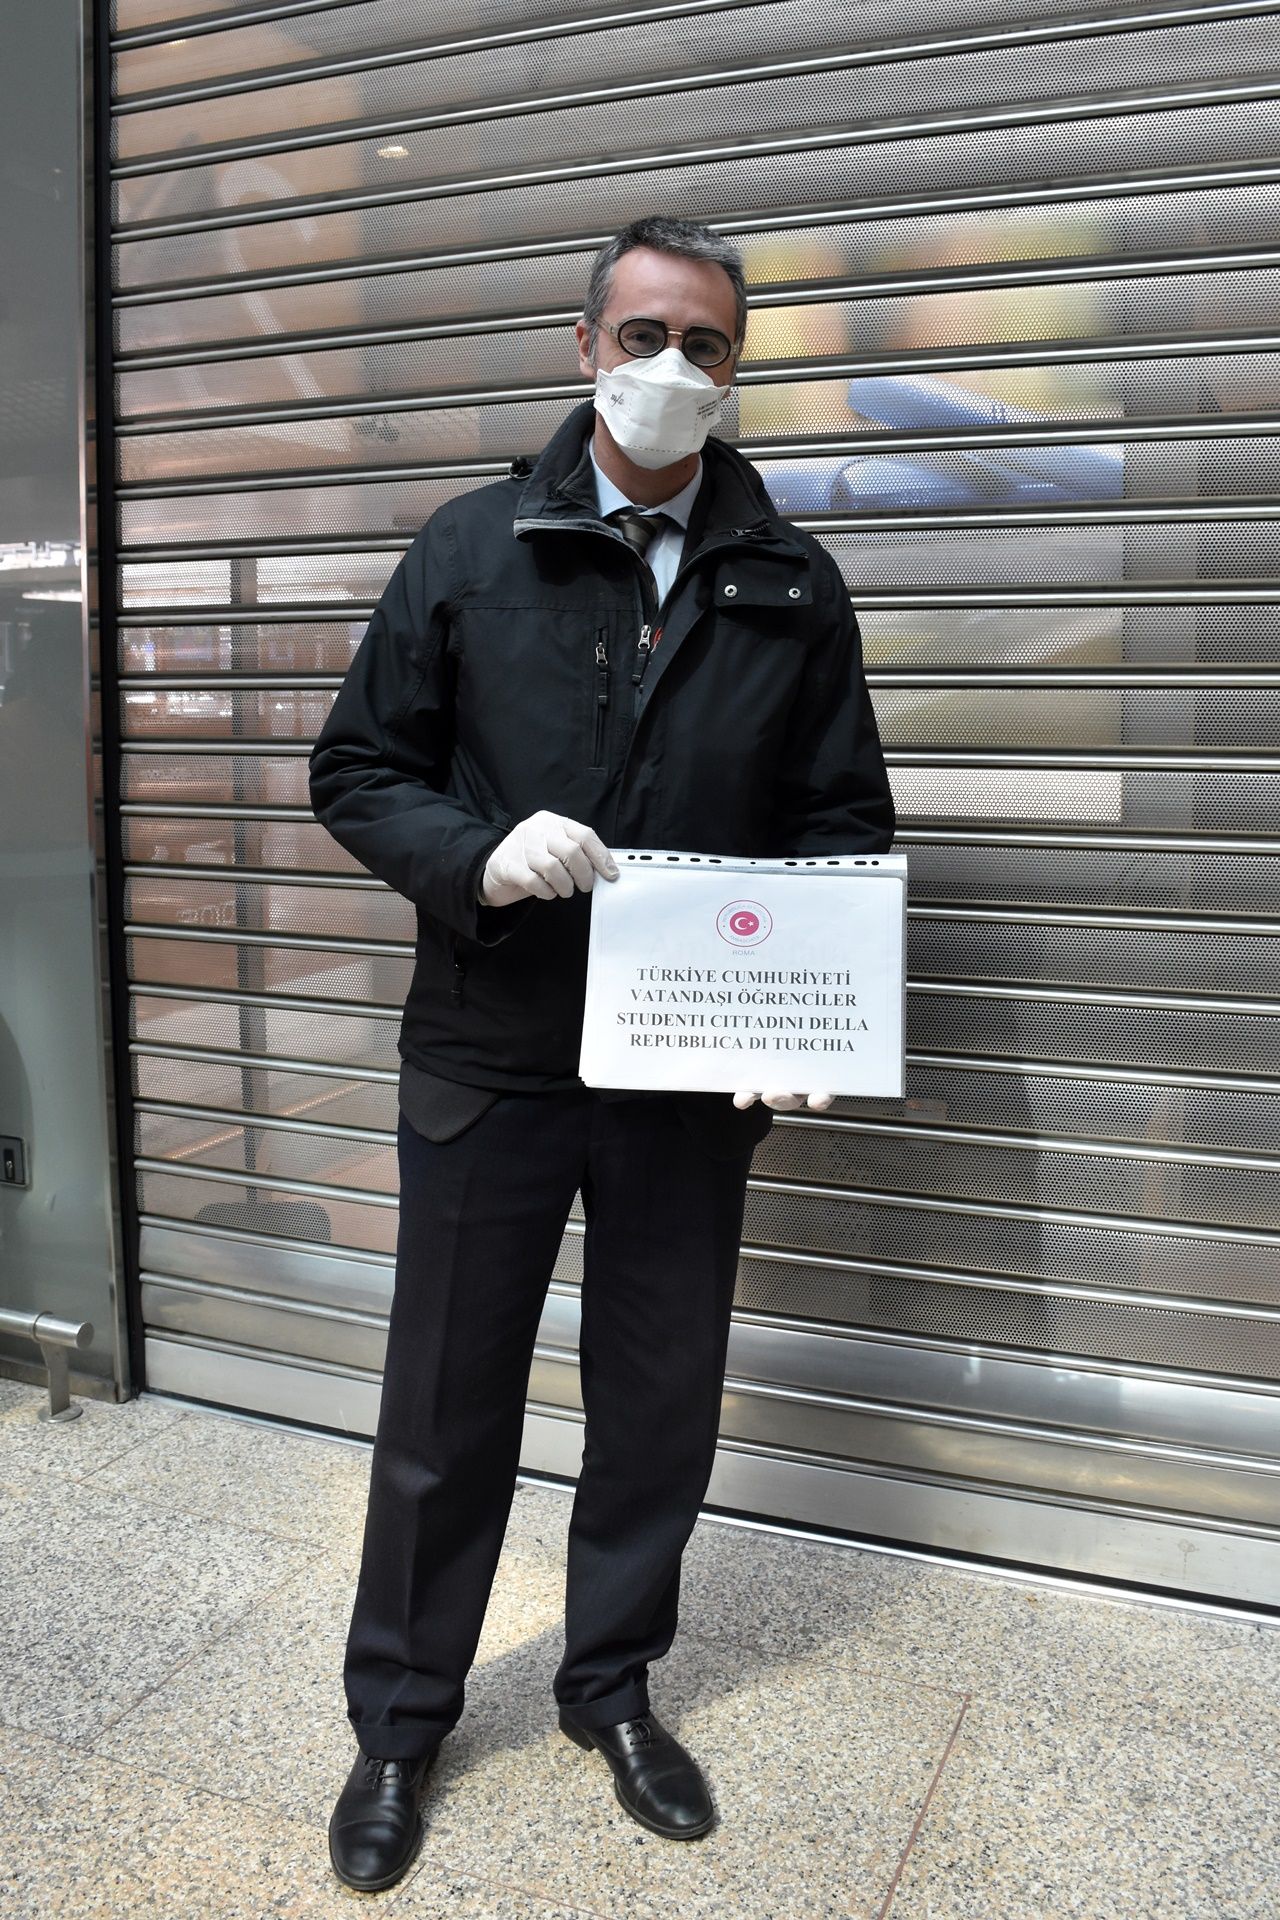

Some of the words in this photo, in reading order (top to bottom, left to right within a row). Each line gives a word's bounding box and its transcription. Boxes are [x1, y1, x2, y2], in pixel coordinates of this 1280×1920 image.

[636, 965, 717, 983] TÜRKİYE
[721, 968, 851, 986] CUMHURİYETİ
[631, 989, 732, 1007] VATANDAŞI
[737, 988, 857, 1007] ÖĞRENCİLER
[616, 1012, 705, 1027] STUDENTI
[710, 1014, 803, 1030] CITTADINI
[809, 1016, 869, 1031] DELLA
[631, 1033, 743, 1049] REPUBBLICA
[749, 1036, 767, 1050] DI
[772, 1037, 855, 1052] TURCHIA
